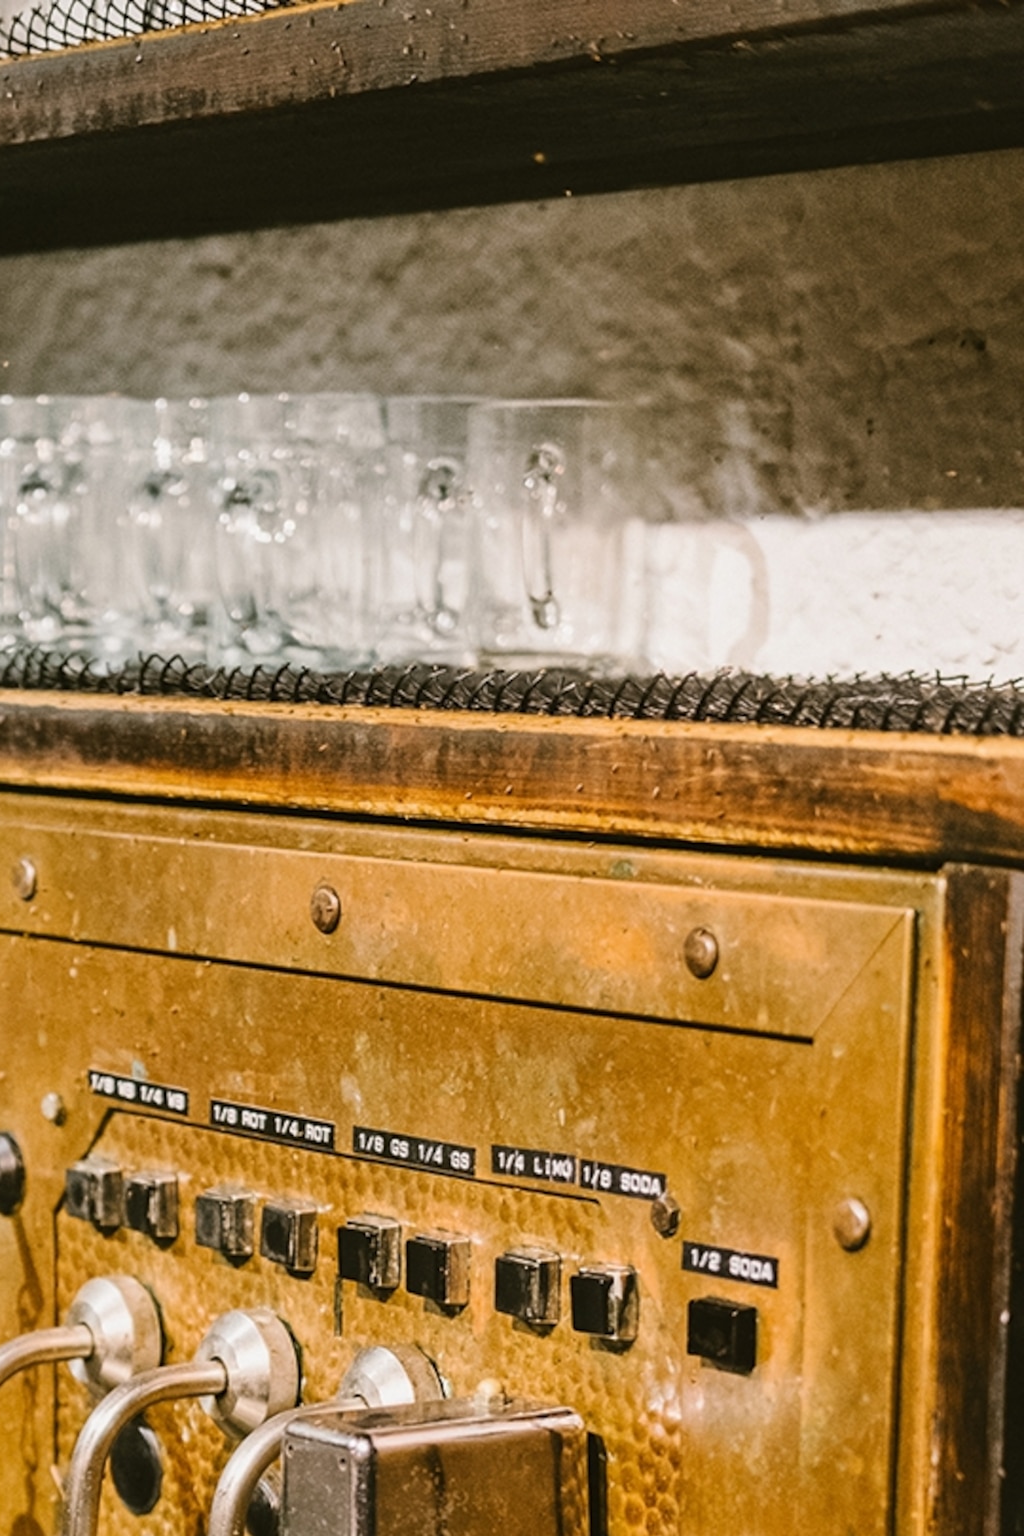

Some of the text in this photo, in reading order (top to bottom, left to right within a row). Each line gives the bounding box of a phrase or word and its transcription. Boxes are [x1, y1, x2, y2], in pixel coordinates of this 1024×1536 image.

[139, 1085, 164, 1105] 1/4
[213, 1104, 332, 1143] 1/8 ROT 1/4 ROT
[358, 1132, 384, 1153] 1/8
[418, 1144, 443, 1164] 1/4
[498, 1151, 525, 1172] 1/4
[583, 1165, 661, 1196] 1/8 SODA
[691, 1247, 774, 1282] 1/2 SODA
